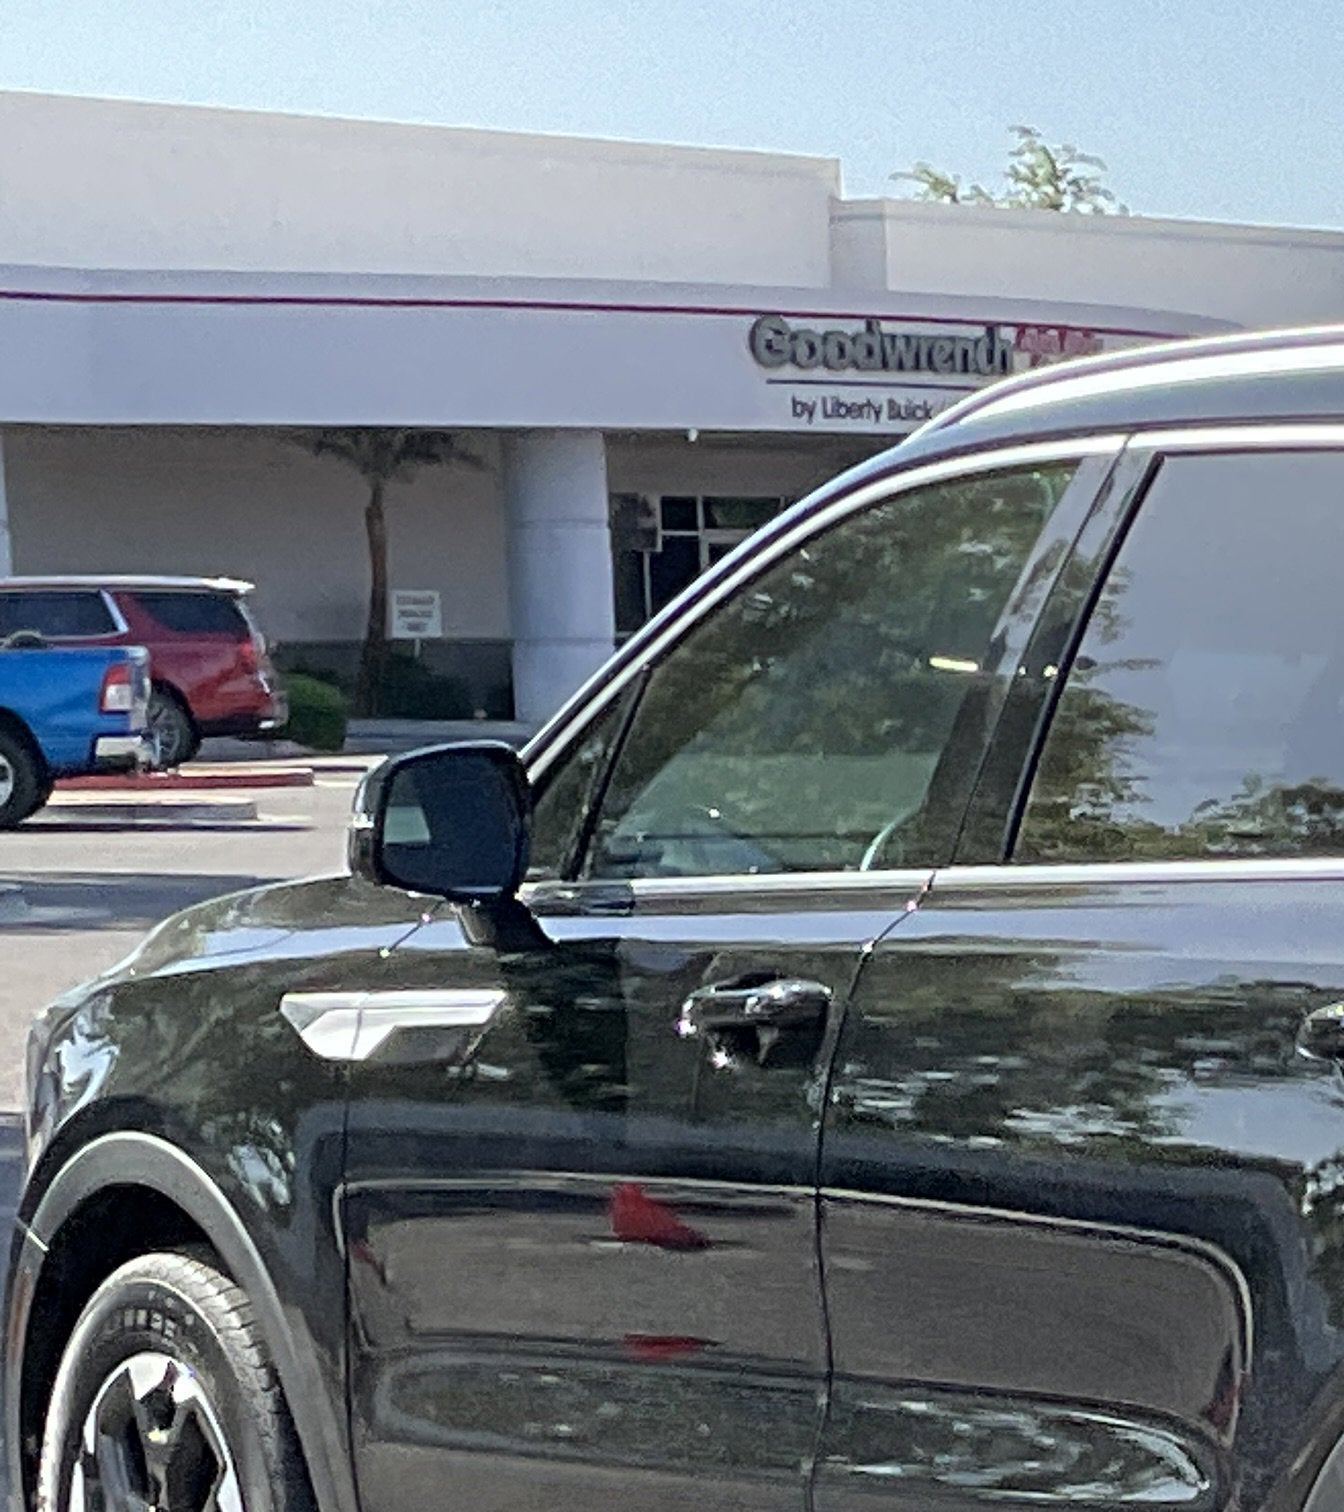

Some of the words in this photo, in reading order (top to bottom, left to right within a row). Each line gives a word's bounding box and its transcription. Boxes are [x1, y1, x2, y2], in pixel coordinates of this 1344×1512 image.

[749, 314, 1014, 376] Goodwrench
[791, 395, 816, 425] by
[822, 396, 883, 424] Liberty
[887, 398, 933, 421] Buick
